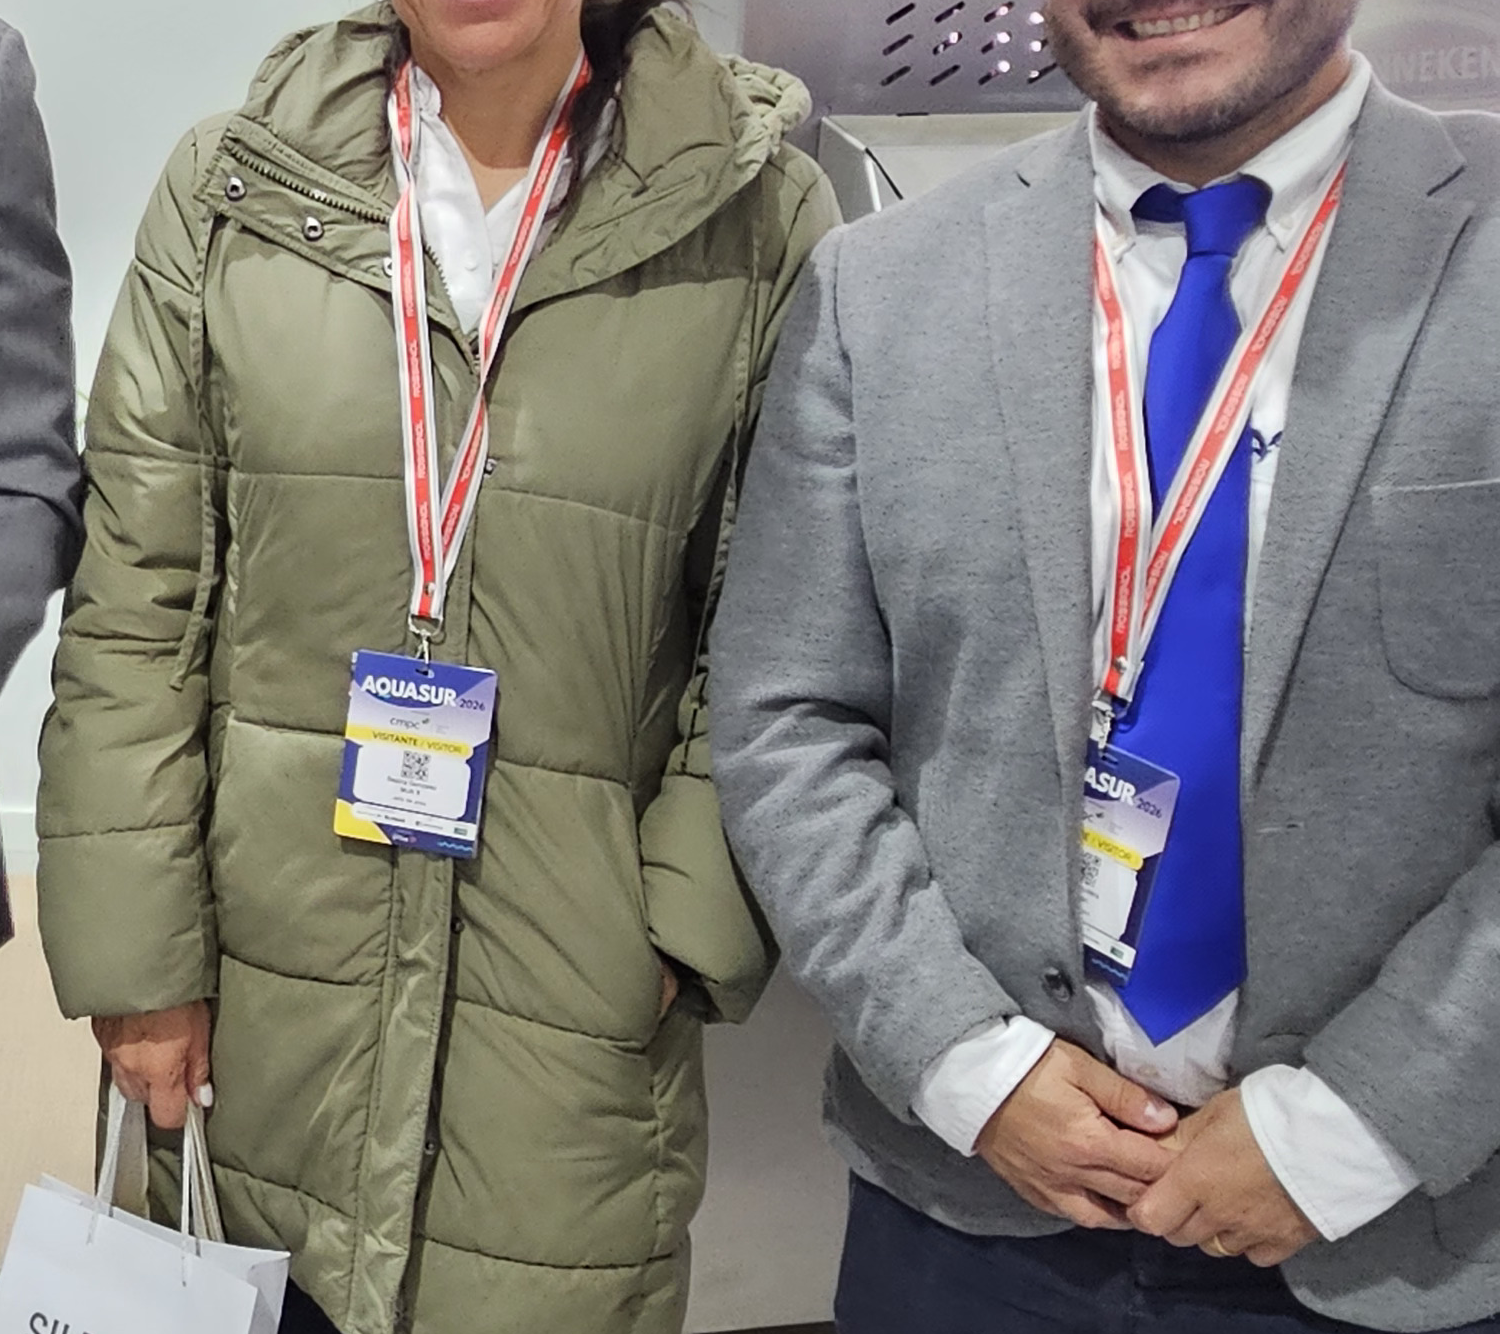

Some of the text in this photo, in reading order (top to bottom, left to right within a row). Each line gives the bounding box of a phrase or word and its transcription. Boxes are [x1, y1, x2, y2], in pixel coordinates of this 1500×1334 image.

[360, 675, 486, 712] AQUASUR 2026
[373, 730, 418, 746] VISITANTE
[427, 741, 462, 754] VISITOR
[1084, 766, 1162, 819] ASUR 2026
